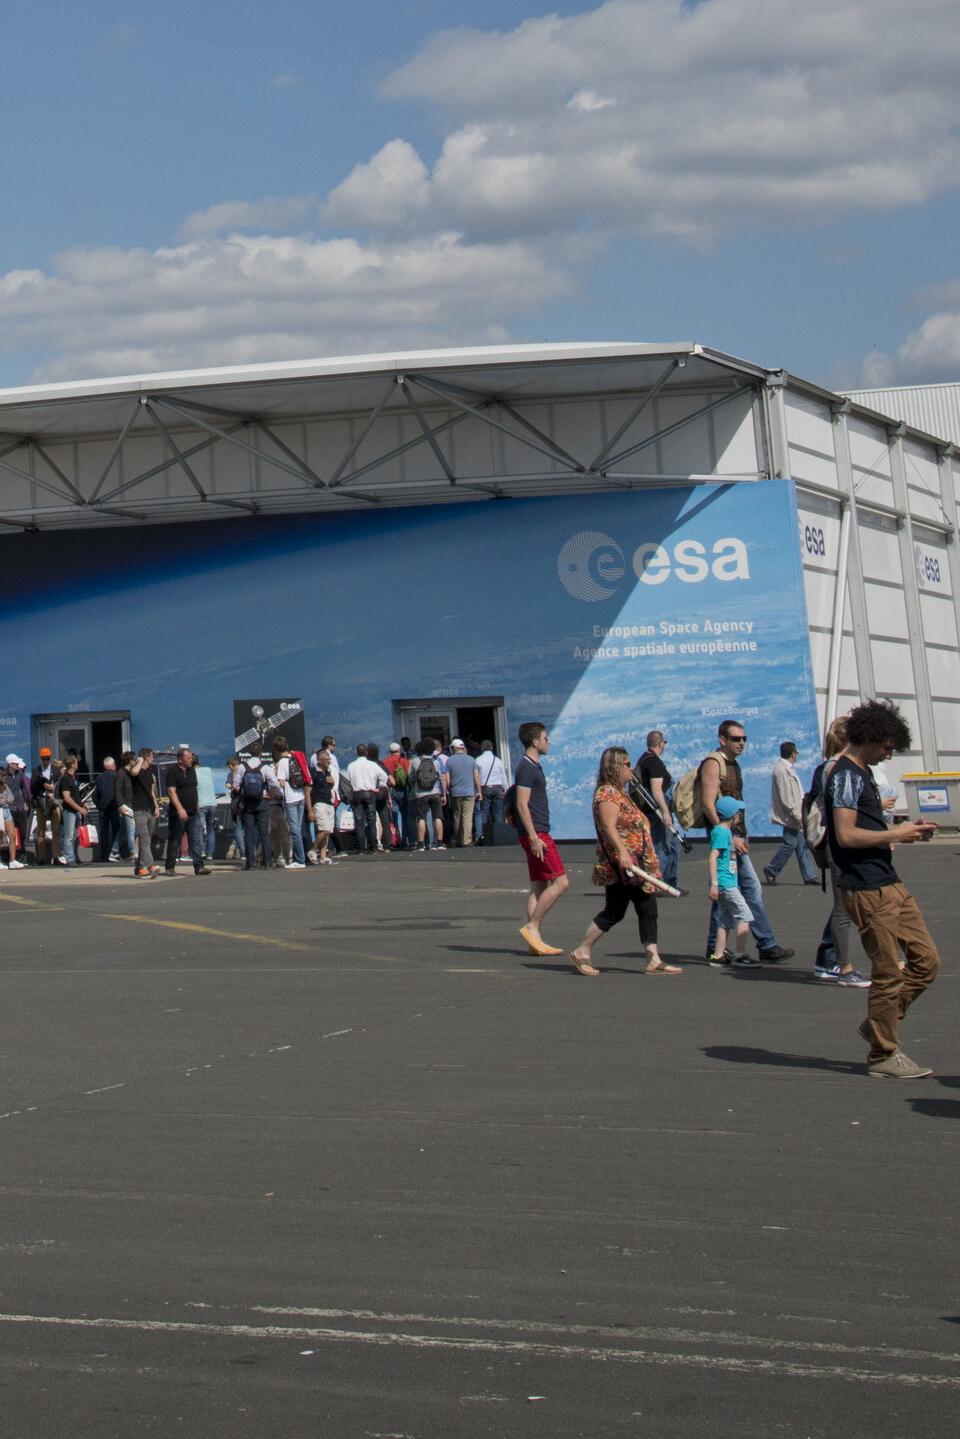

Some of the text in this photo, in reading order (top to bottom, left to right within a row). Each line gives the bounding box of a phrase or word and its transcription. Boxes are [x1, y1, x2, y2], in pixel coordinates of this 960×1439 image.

[805, 525, 825, 556] esa
[633, 537, 750, 585] esa
[924, 556, 941, 582] esa
[593, 620, 754, 639] European Space Agency
[573, 639, 757, 661] Agence spatiale européenne
[0, 716, 17, 726] esa
[701, 706, 759, 716] #SpaceBourget
